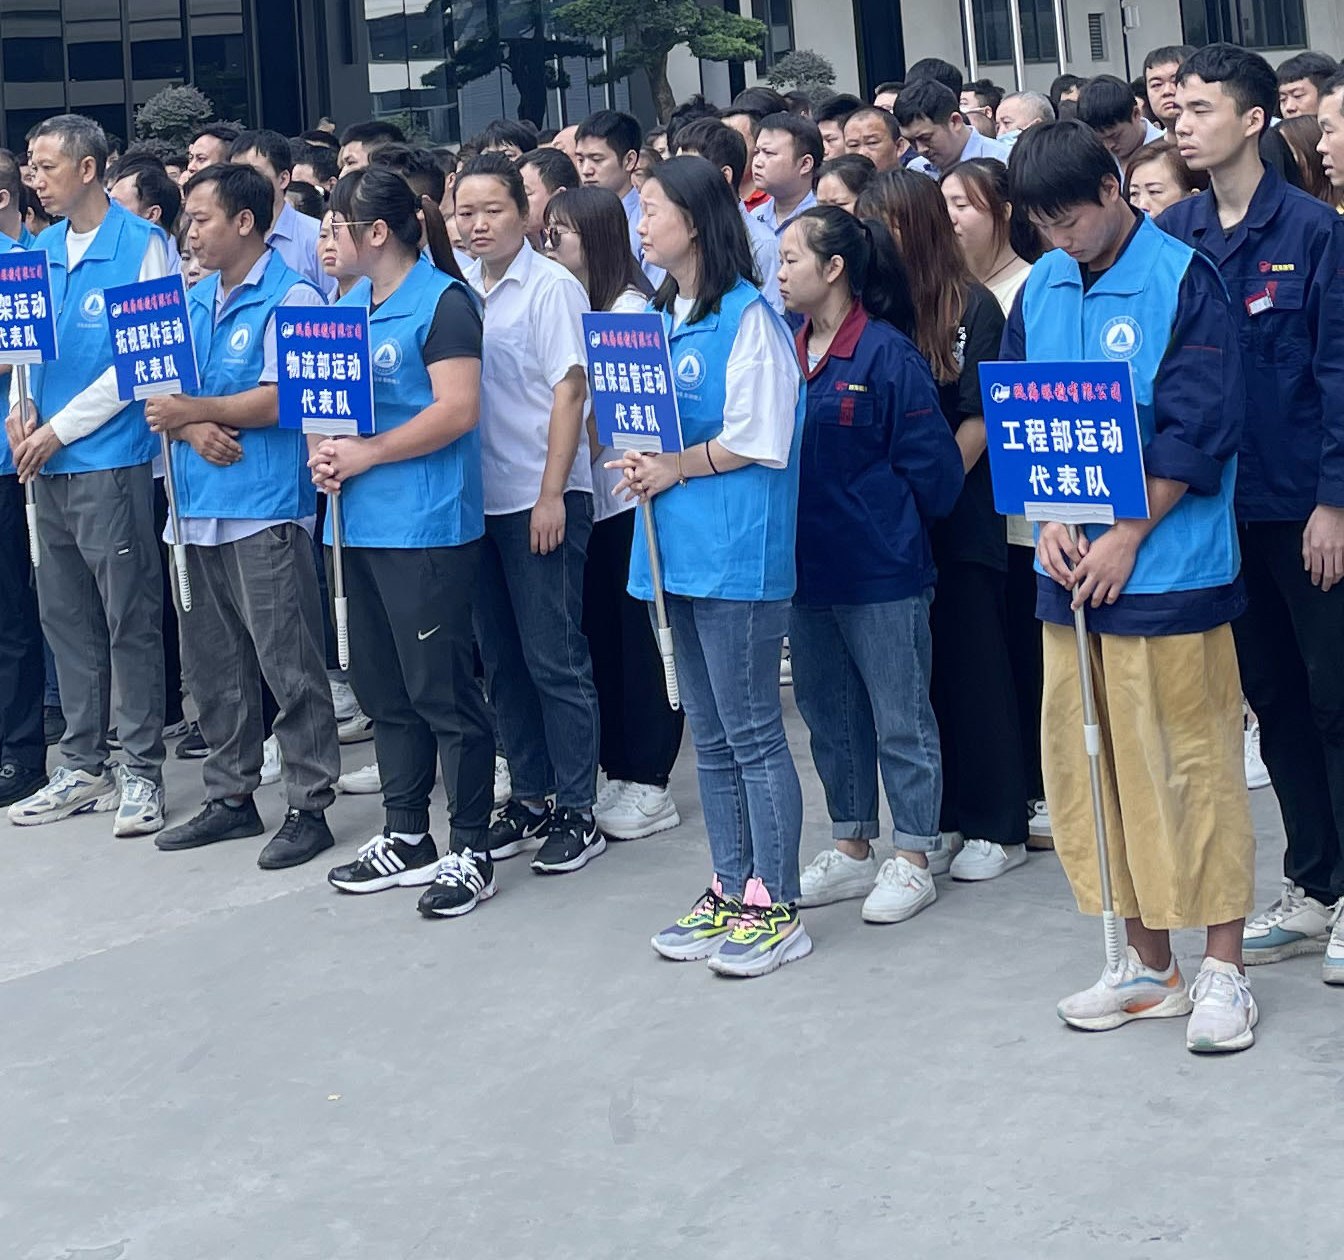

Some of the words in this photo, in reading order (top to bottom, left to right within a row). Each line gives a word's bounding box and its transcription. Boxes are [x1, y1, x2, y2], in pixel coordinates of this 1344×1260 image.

[135, 354, 178, 383] 代表队
[286, 351, 361, 381] 物流部运动
[593, 362, 667, 395] 品保品管运动
[301, 388, 351, 415] 代表队
[615, 403, 660, 433] 代表队
[1001, 418, 1124, 454] 工程部运动
[1029, 464, 1111, 497] 代表队
